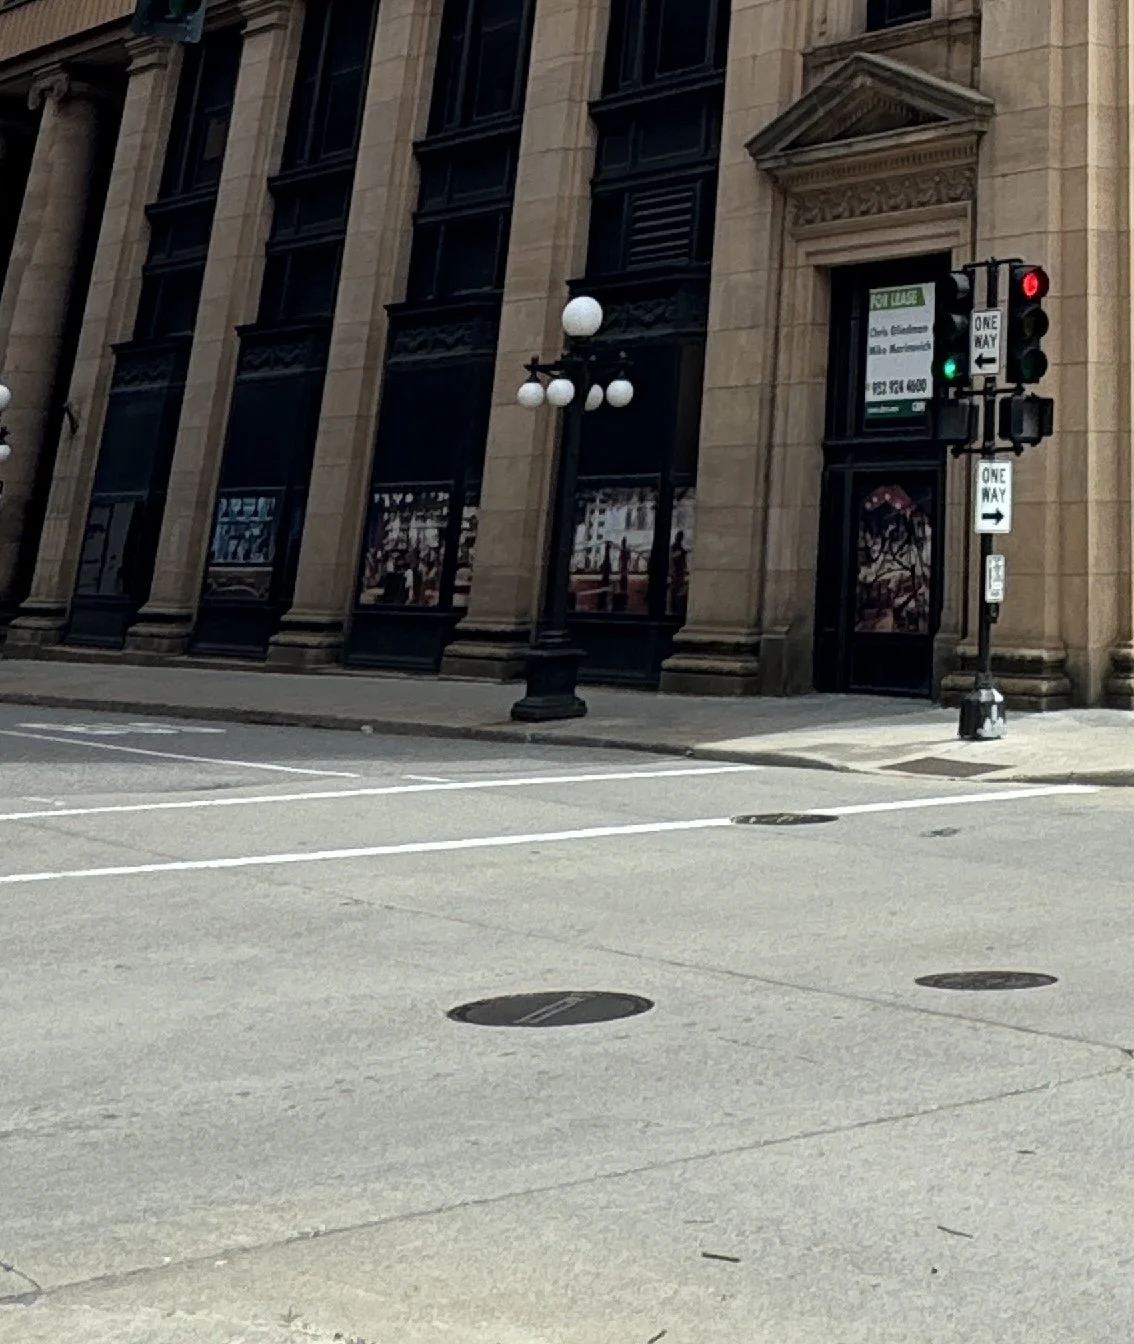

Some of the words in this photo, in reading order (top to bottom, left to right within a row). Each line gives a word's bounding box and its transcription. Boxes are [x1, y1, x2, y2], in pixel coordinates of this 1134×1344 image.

[870, 293, 888, 310] FOR
[890, 290, 918, 307] LEASE
[975, 316, 998, 330] ONE
[974, 334, 998, 350] WAY
[982, 467, 1007, 484] ONE
[981, 487, 1007, 504] WAY
